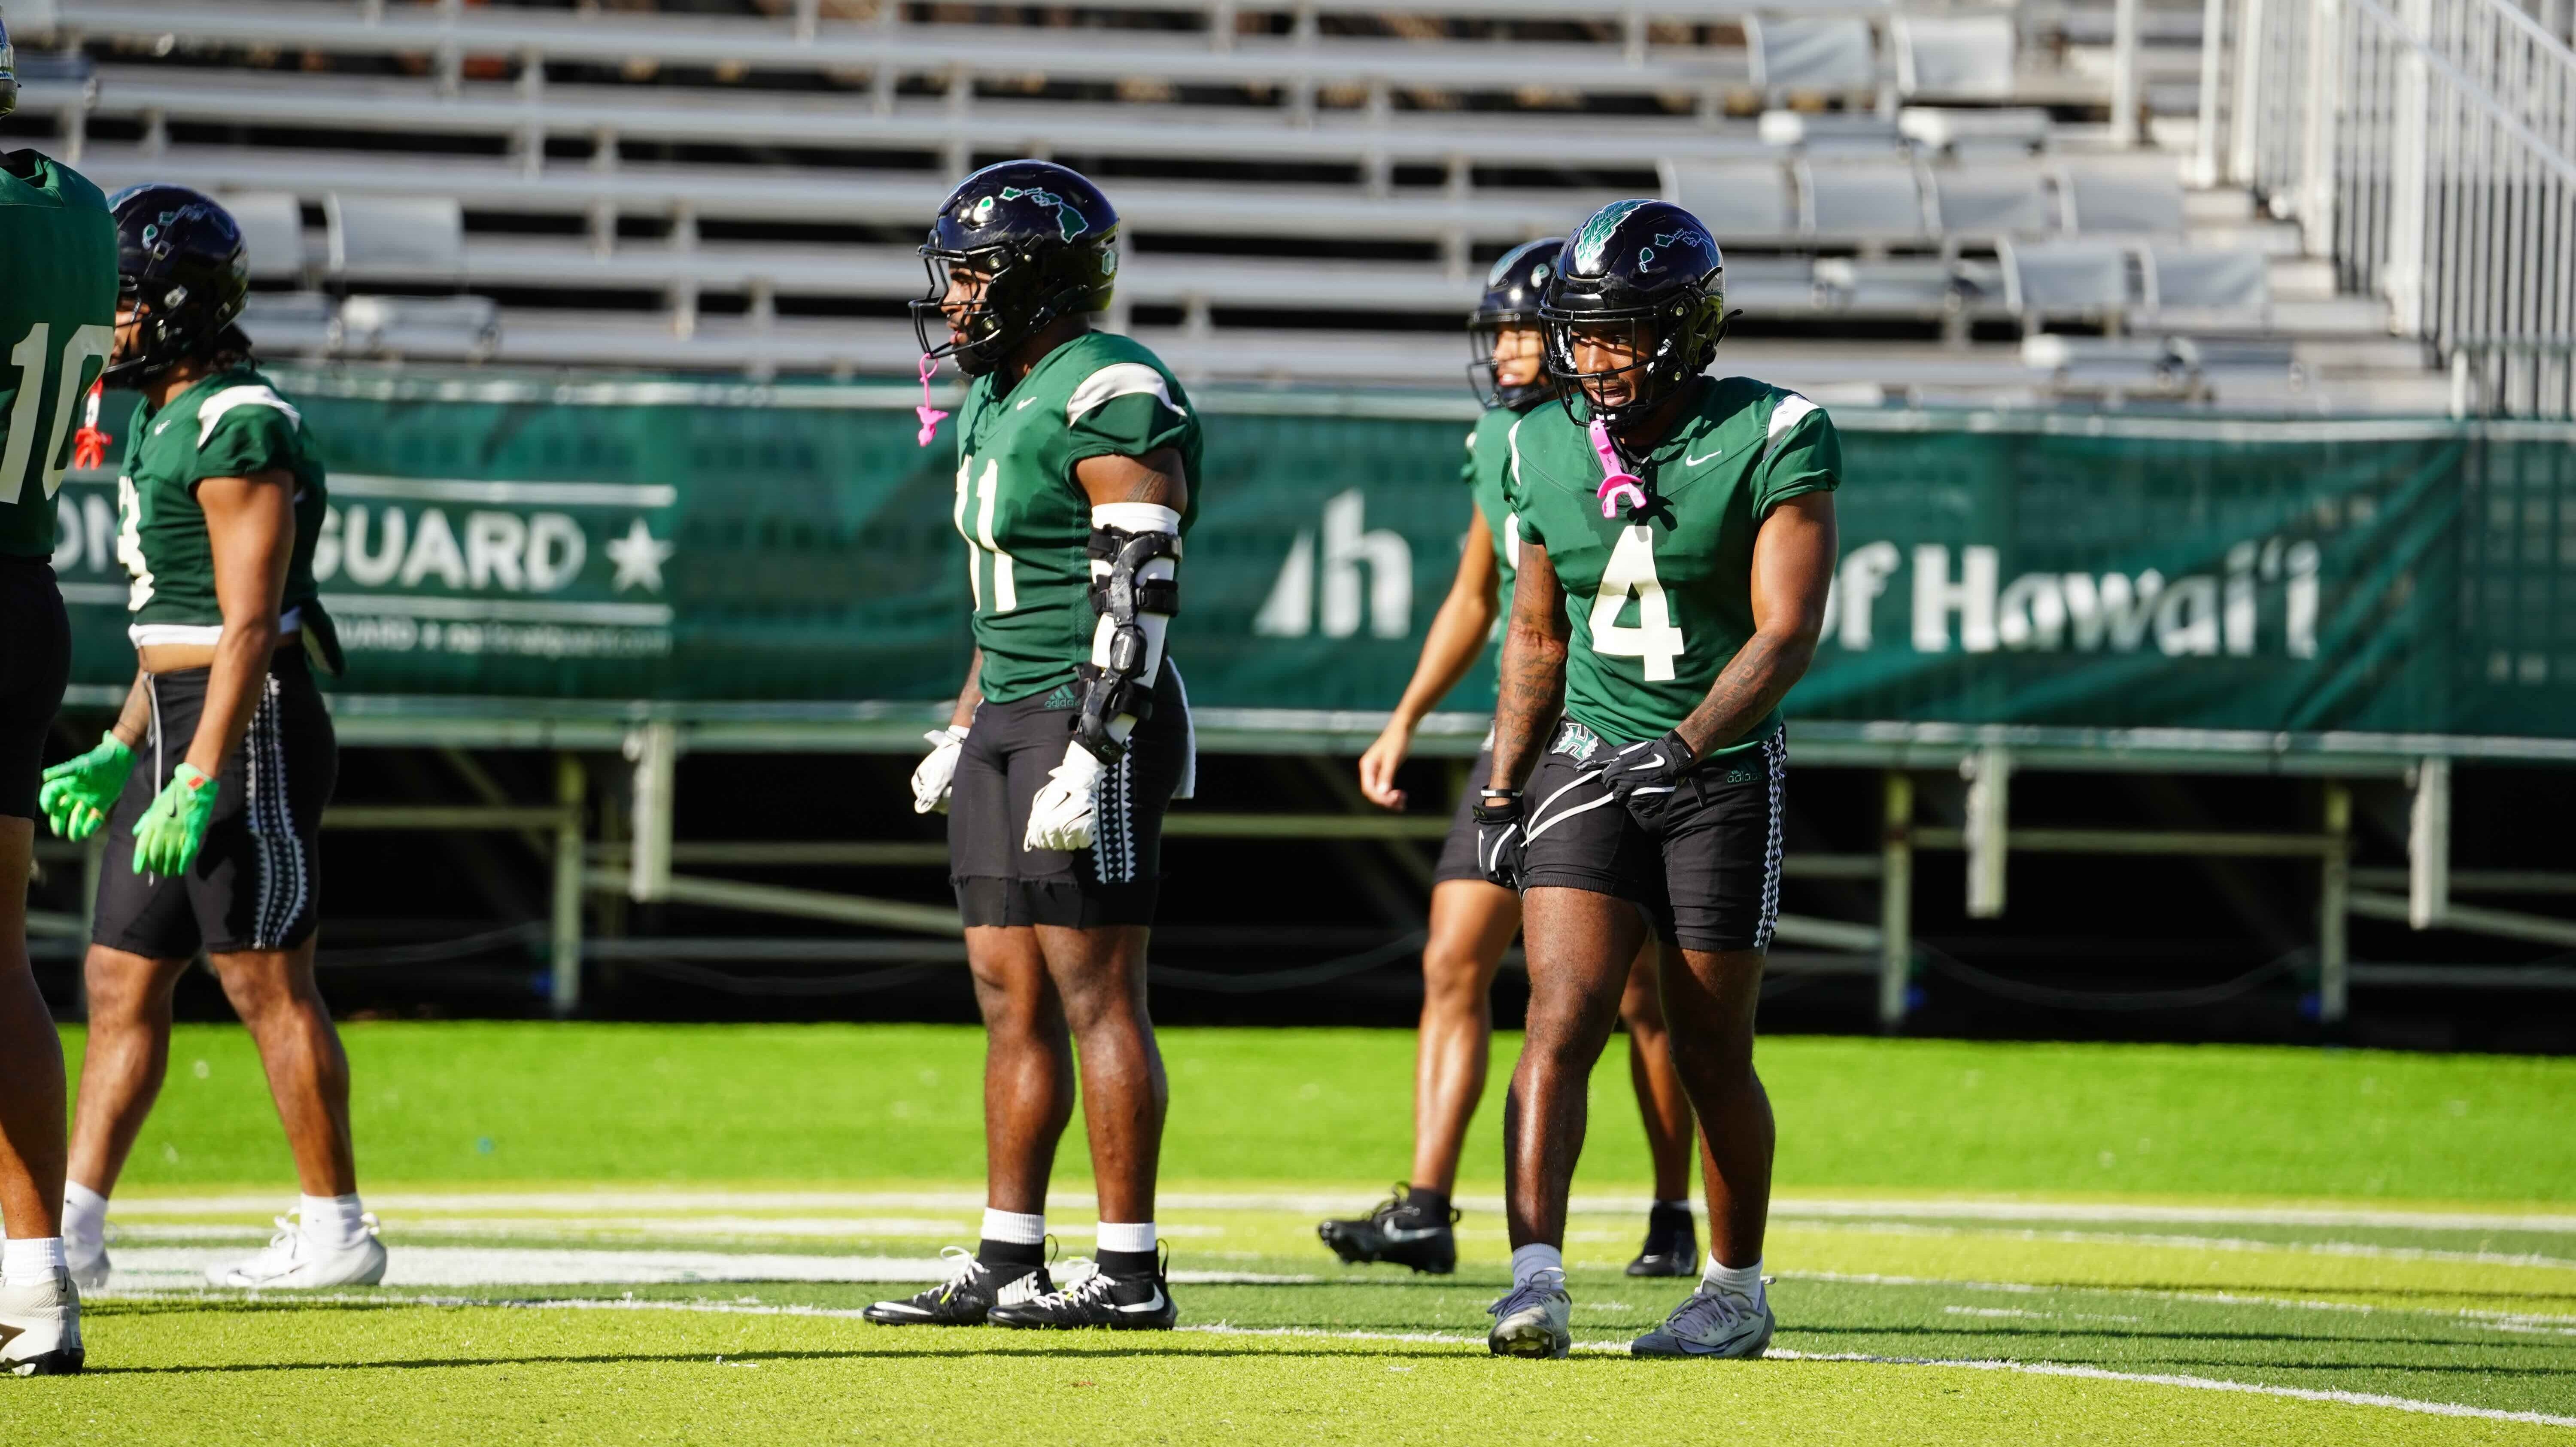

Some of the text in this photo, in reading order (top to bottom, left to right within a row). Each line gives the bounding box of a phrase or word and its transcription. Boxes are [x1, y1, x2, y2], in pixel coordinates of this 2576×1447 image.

[0, 323, 115, 504] 10
[954, 454, 1017, 612] 11
[1589, 525, 1684, 681] 4
[1044, 697, 1081, 708] adidas
[1727, 771, 1762, 783] adidas
[997, 1271, 1041, 1305] NIKE
